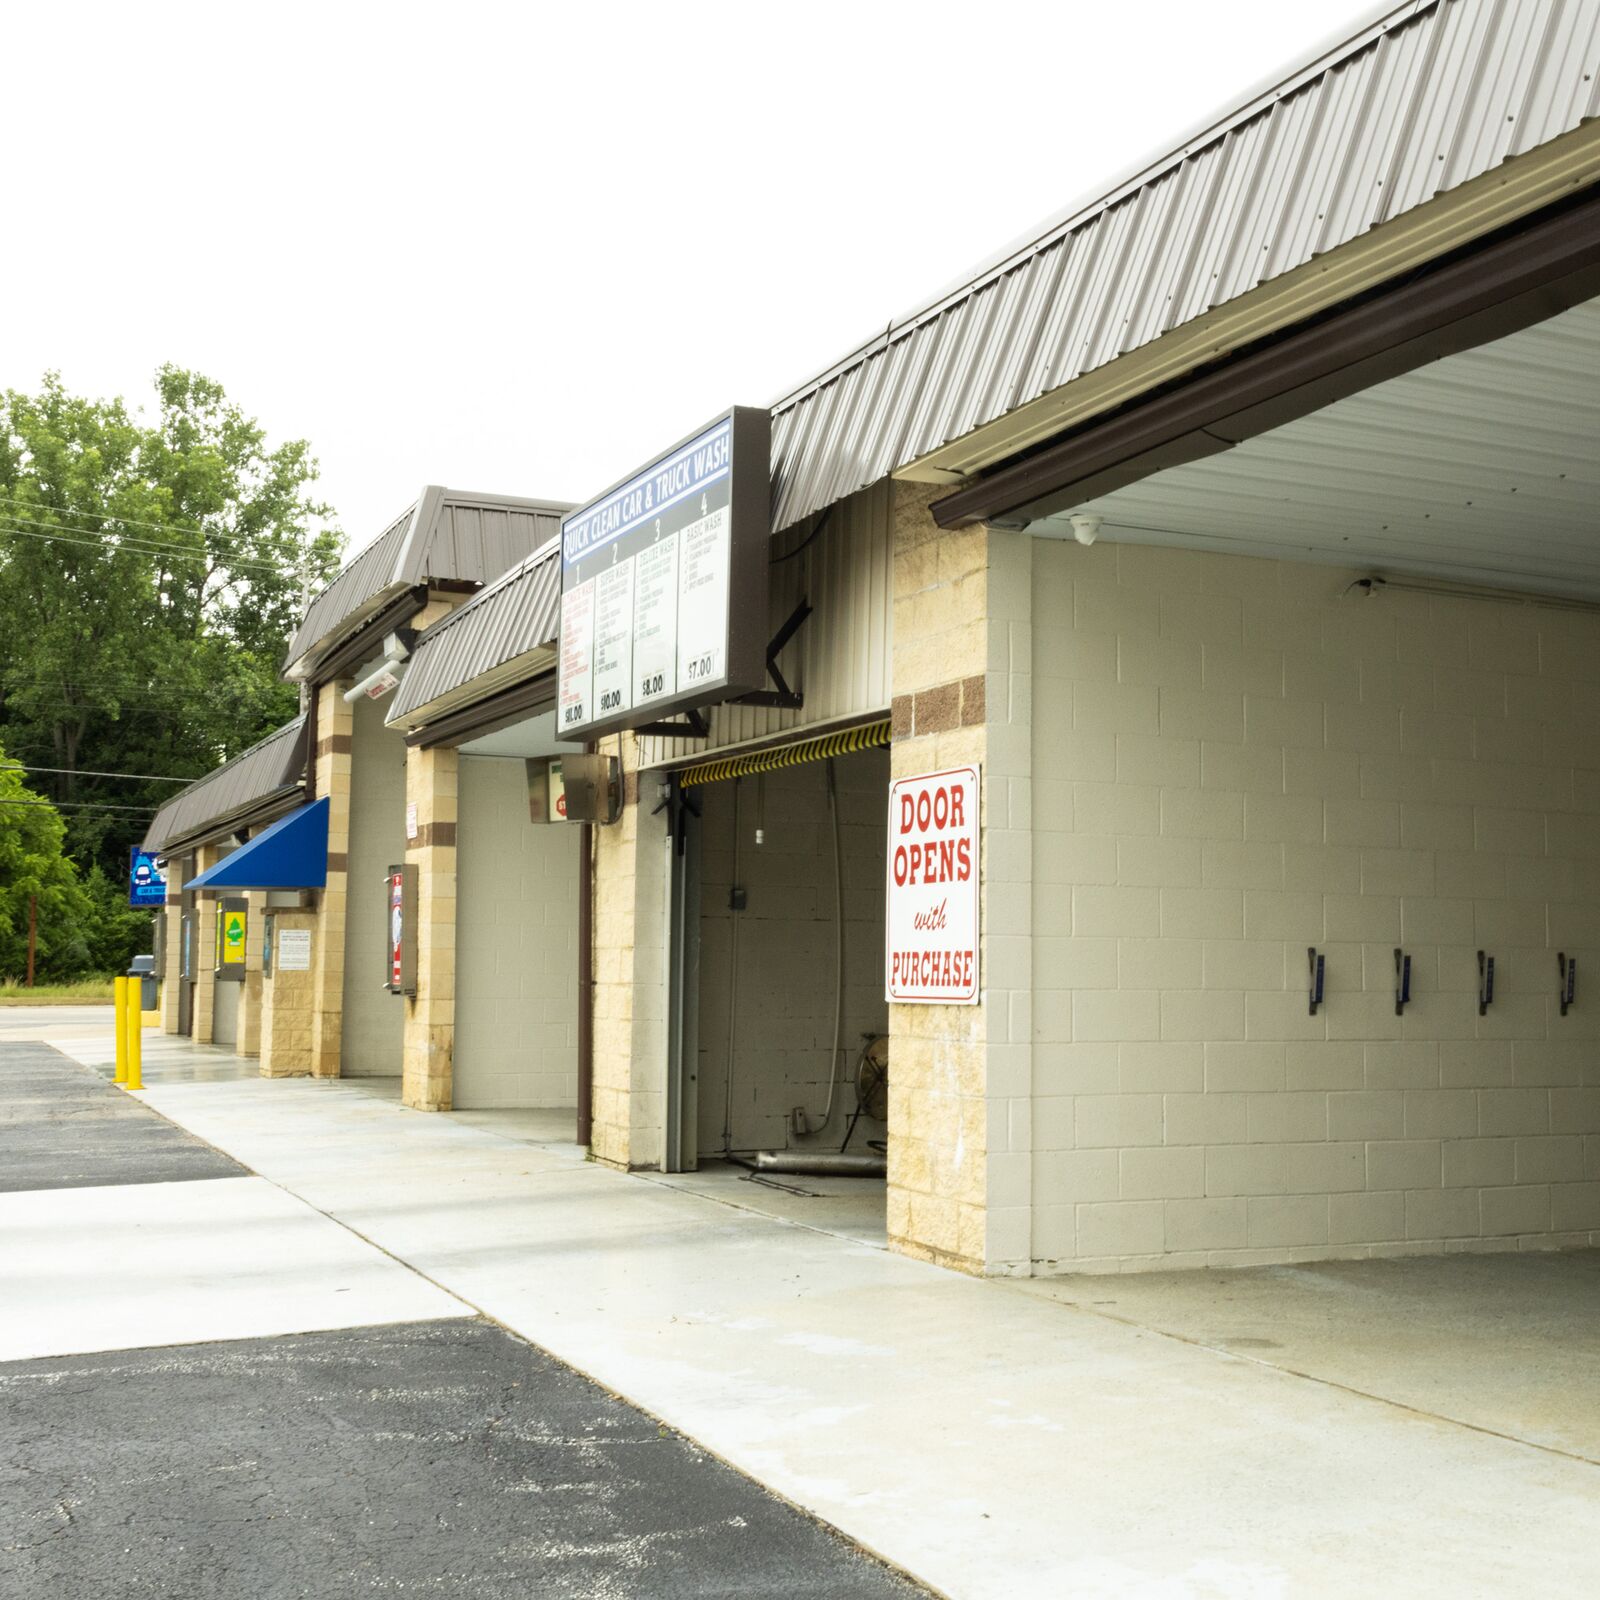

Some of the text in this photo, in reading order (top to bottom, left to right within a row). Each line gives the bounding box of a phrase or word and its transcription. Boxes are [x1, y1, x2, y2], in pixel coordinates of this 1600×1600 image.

[564, 434, 730, 560] QUICK CLEAN CAR & TRUCK WASH
[701, 493, 708, 516] 4
[654, 518, 661, 542] 3
[704, 511, 722, 532] WASH
[612, 542, 618, 564] 2
[575, 564, 580, 585] 1
[688, 655, 712, 679] $7.00
[642, 674, 664, 696] $8.00
[601, 689, 621, 711] $10.00
[900, 784, 965, 835] DOOR
[893, 837, 971, 887] OPENS
[913, 897, 948, 931] with
[891, 950, 973, 987] PURCHASE
